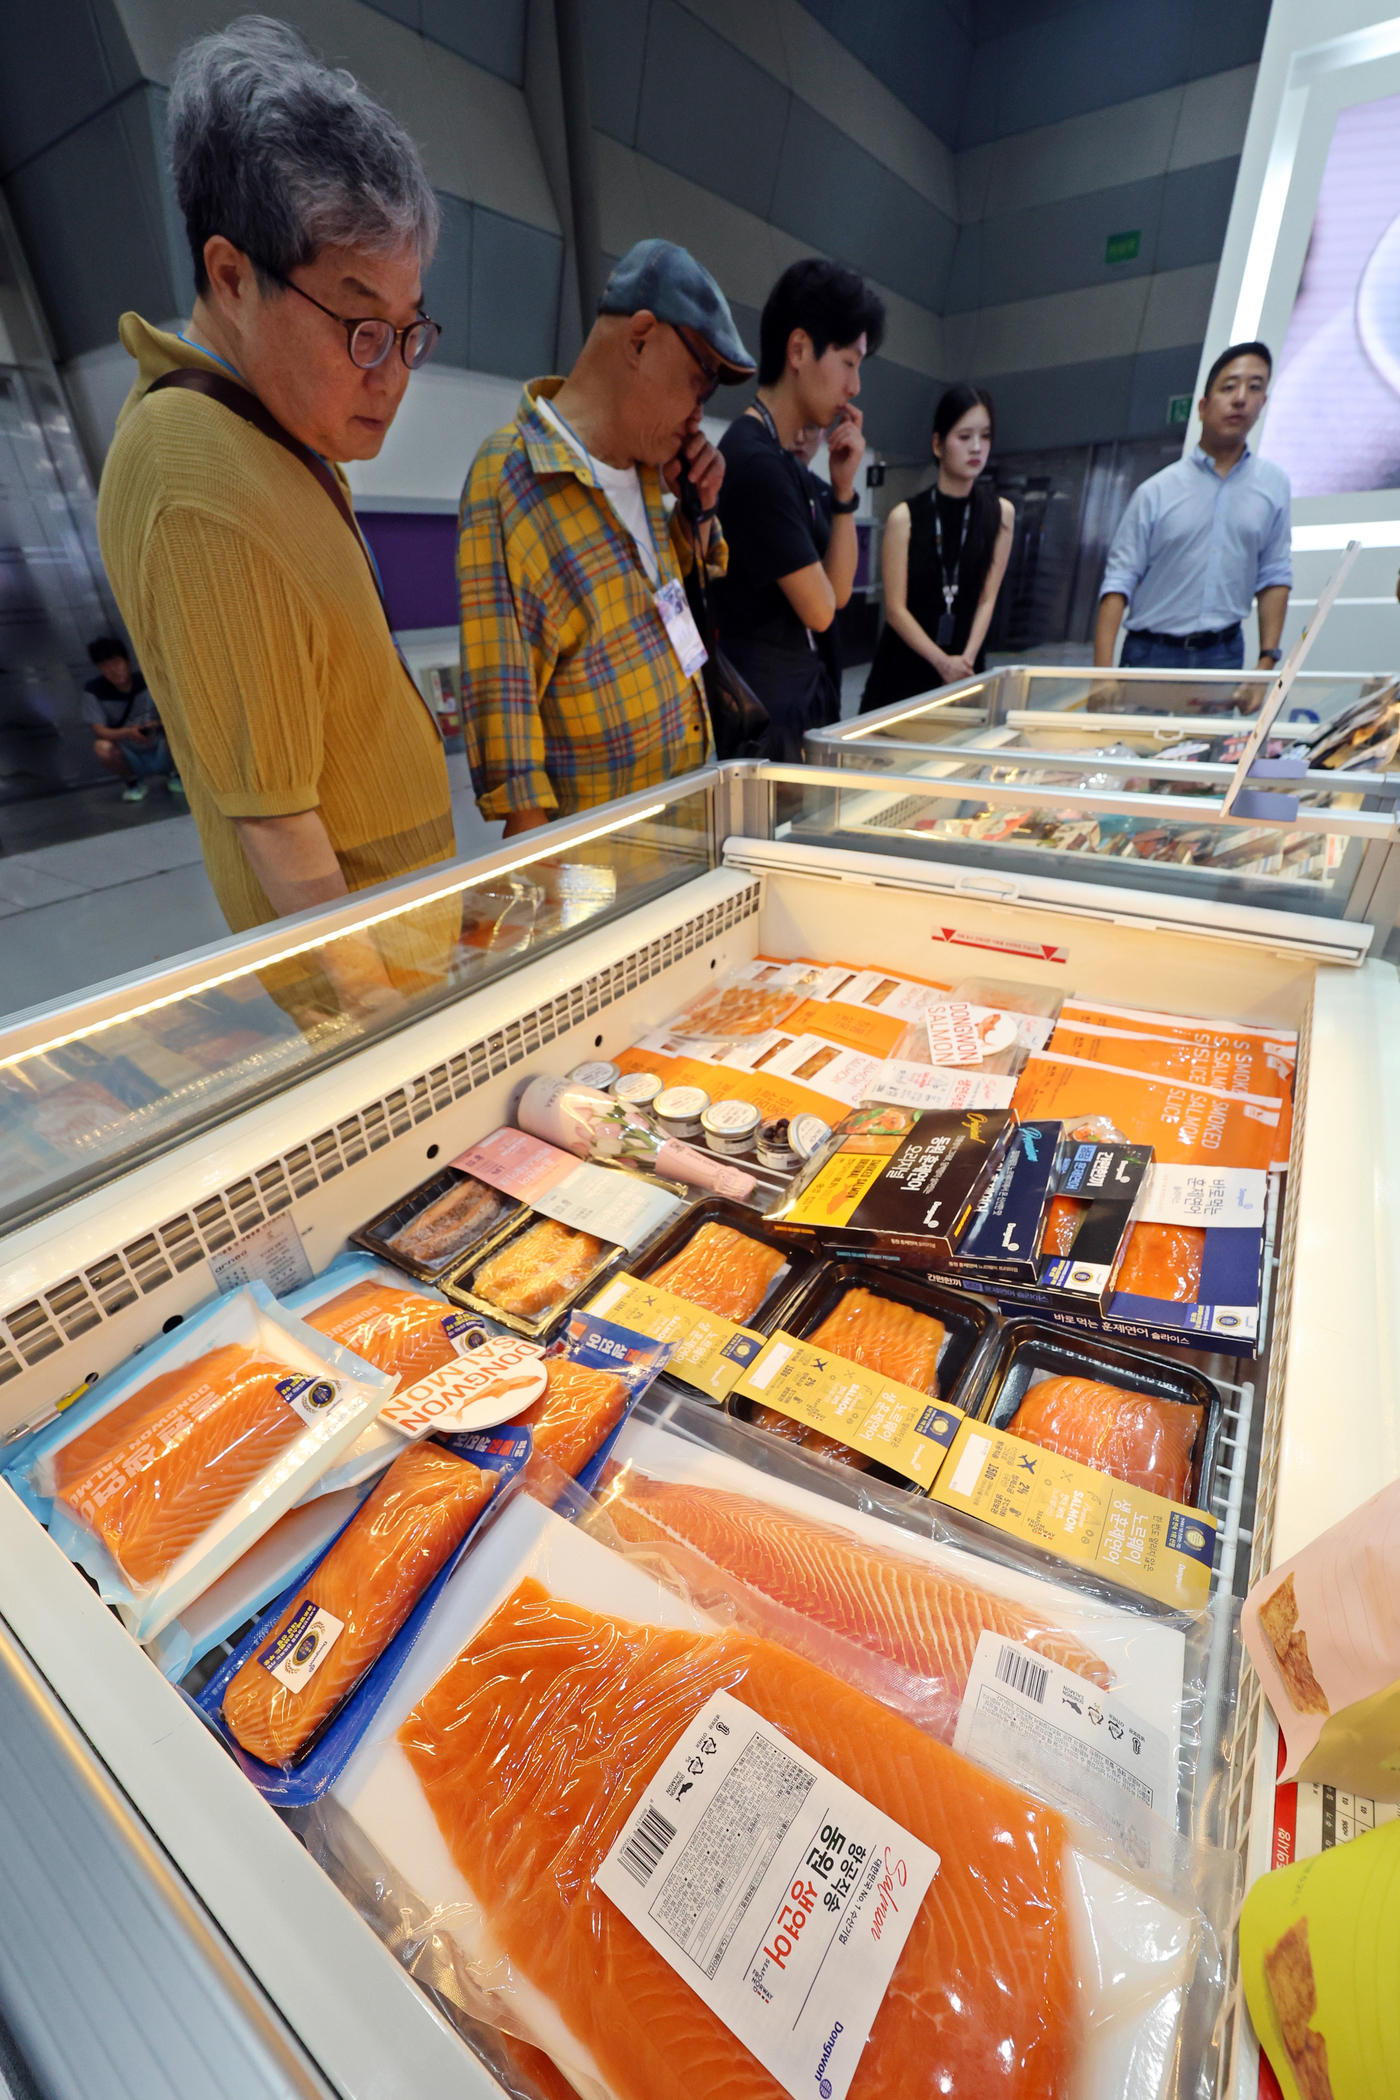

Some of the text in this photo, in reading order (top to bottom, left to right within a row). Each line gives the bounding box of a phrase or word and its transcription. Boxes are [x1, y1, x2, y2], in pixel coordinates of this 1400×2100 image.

[927, 1006, 955, 1062] SALMON
[949, 1002, 978, 1061] DONGWON
[1188, 1047, 1209, 1083] SLICE
[1160, 1088, 1186, 1123] SLICE
[1177, 1092, 1207, 1144] SALMON
[1201, 1097, 1228, 1148] SMOKED
[885, 1144, 923, 1181] 오리지널
[925, 1136, 951, 1156] 동원
[899, 1155, 936, 1191] 훈제연어
[1086, 1150, 1113, 1187] 간편한끼
[922, 1200, 942, 1224] Dongwon
[1183, 1176, 1204, 1214] 훈제연어
[1001, 1221, 1015, 1248] Dongwon
[927, 1272, 962, 1287] 간편한끼
[584, 1332, 627, 1359] 생연어
[672, 1329, 705, 1364] 훈제연어
[686, 1331, 718, 1364] 노르웨이
[1101, 1321, 1148, 1338] 훈제연어
[1151, 1330, 1189, 1345] 슬라이스
[379, 1336, 516, 1420] SALMON
[398, 1342, 538, 1432] DONGWON
[834, 1382, 860, 1416] SALMON
[155, 1389, 225, 1447] 동원
[857, 1400, 892, 1441] 훈제연어
[875, 1401, 907, 1441] 노르웨이
[66, 1383, 210, 1505] DONGWON SALMO
[452, 1432, 491, 1452] 생연어
[1063, 1489, 1084, 1532] SALMON
[1101, 1498, 1130, 1564] 생 훈제연어
[1124, 1512, 1148, 1563] 노르웨이
[1146, 1536, 1158, 1556] 얼리지
[693, 1731, 708, 1748] OTHER
[664, 1770, 682, 1794] SALMON
[667, 1773, 685, 1797] DONGWON
[805, 1822, 848, 1880] 동원
[819, 1841, 867, 1915] 항공직송
[862, 1858, 882, 1890] 대한민국
[868, 1846, 910, 1943] Salmon
[762, 1878, 822, 1970] 생연어
[837, 1909, 859, 1944] 수산기업
[751, 1958, 770, 1993] SEAFOOD
[813, 2020, 844, 2081] Dongwon
